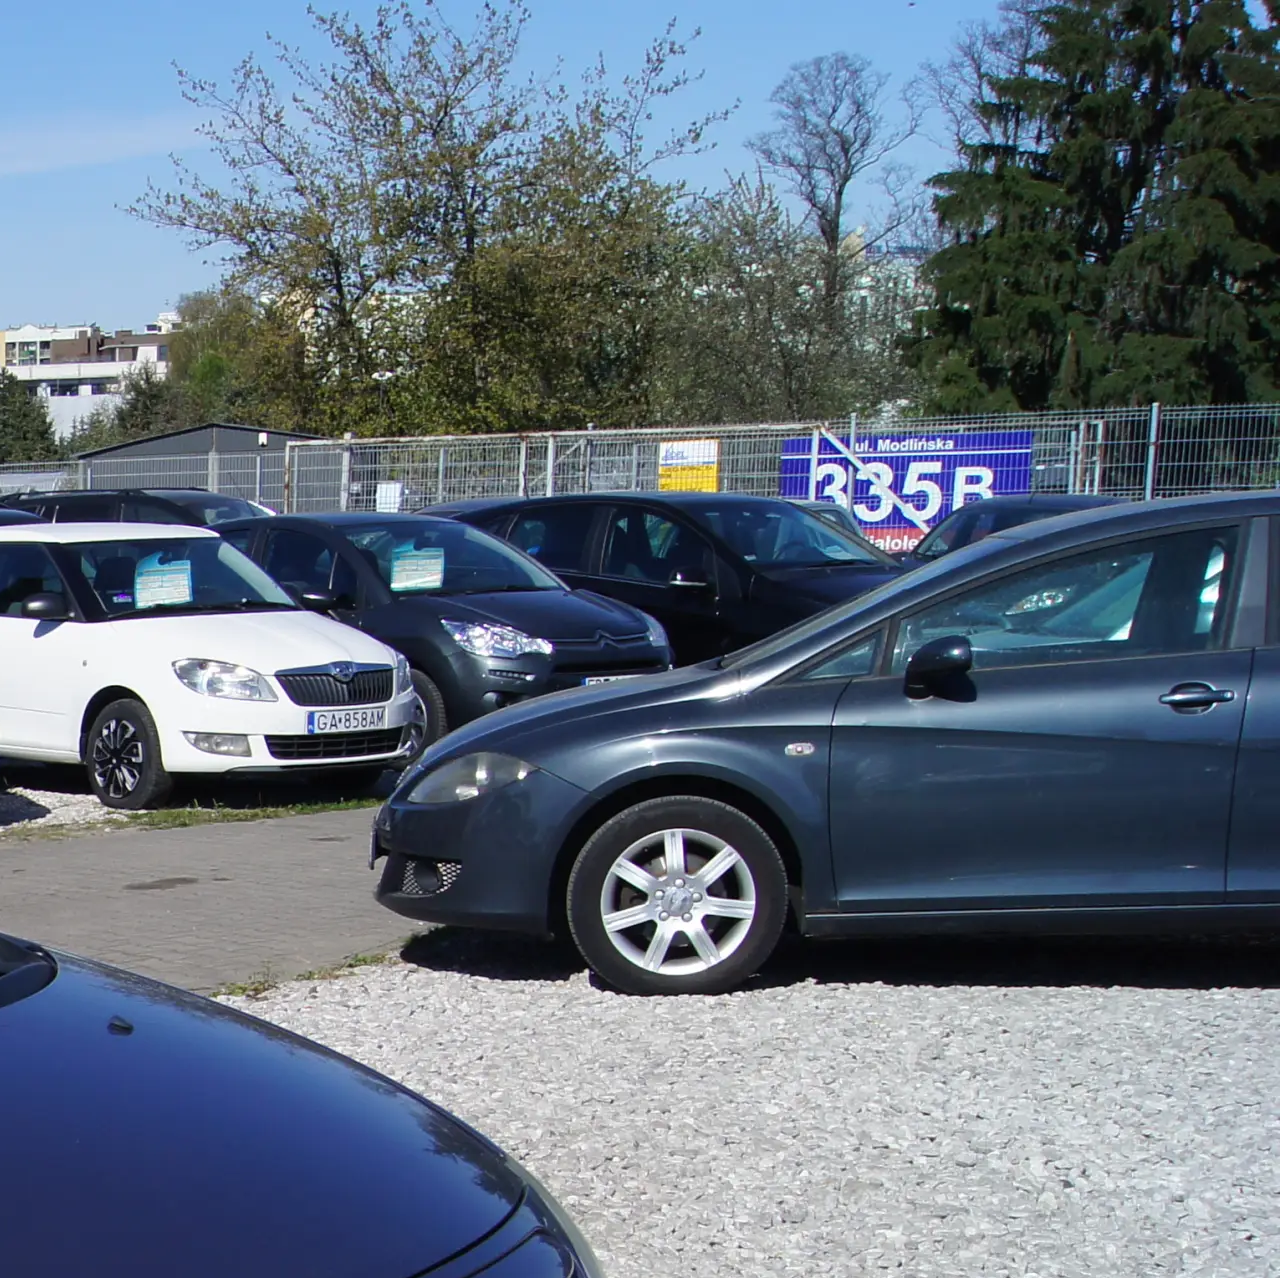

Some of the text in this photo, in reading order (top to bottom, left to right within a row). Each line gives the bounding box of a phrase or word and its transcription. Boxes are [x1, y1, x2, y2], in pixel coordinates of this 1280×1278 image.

[855, 441, 873, 453] ul.
[317, 708, 384, 732] GA 858AM
